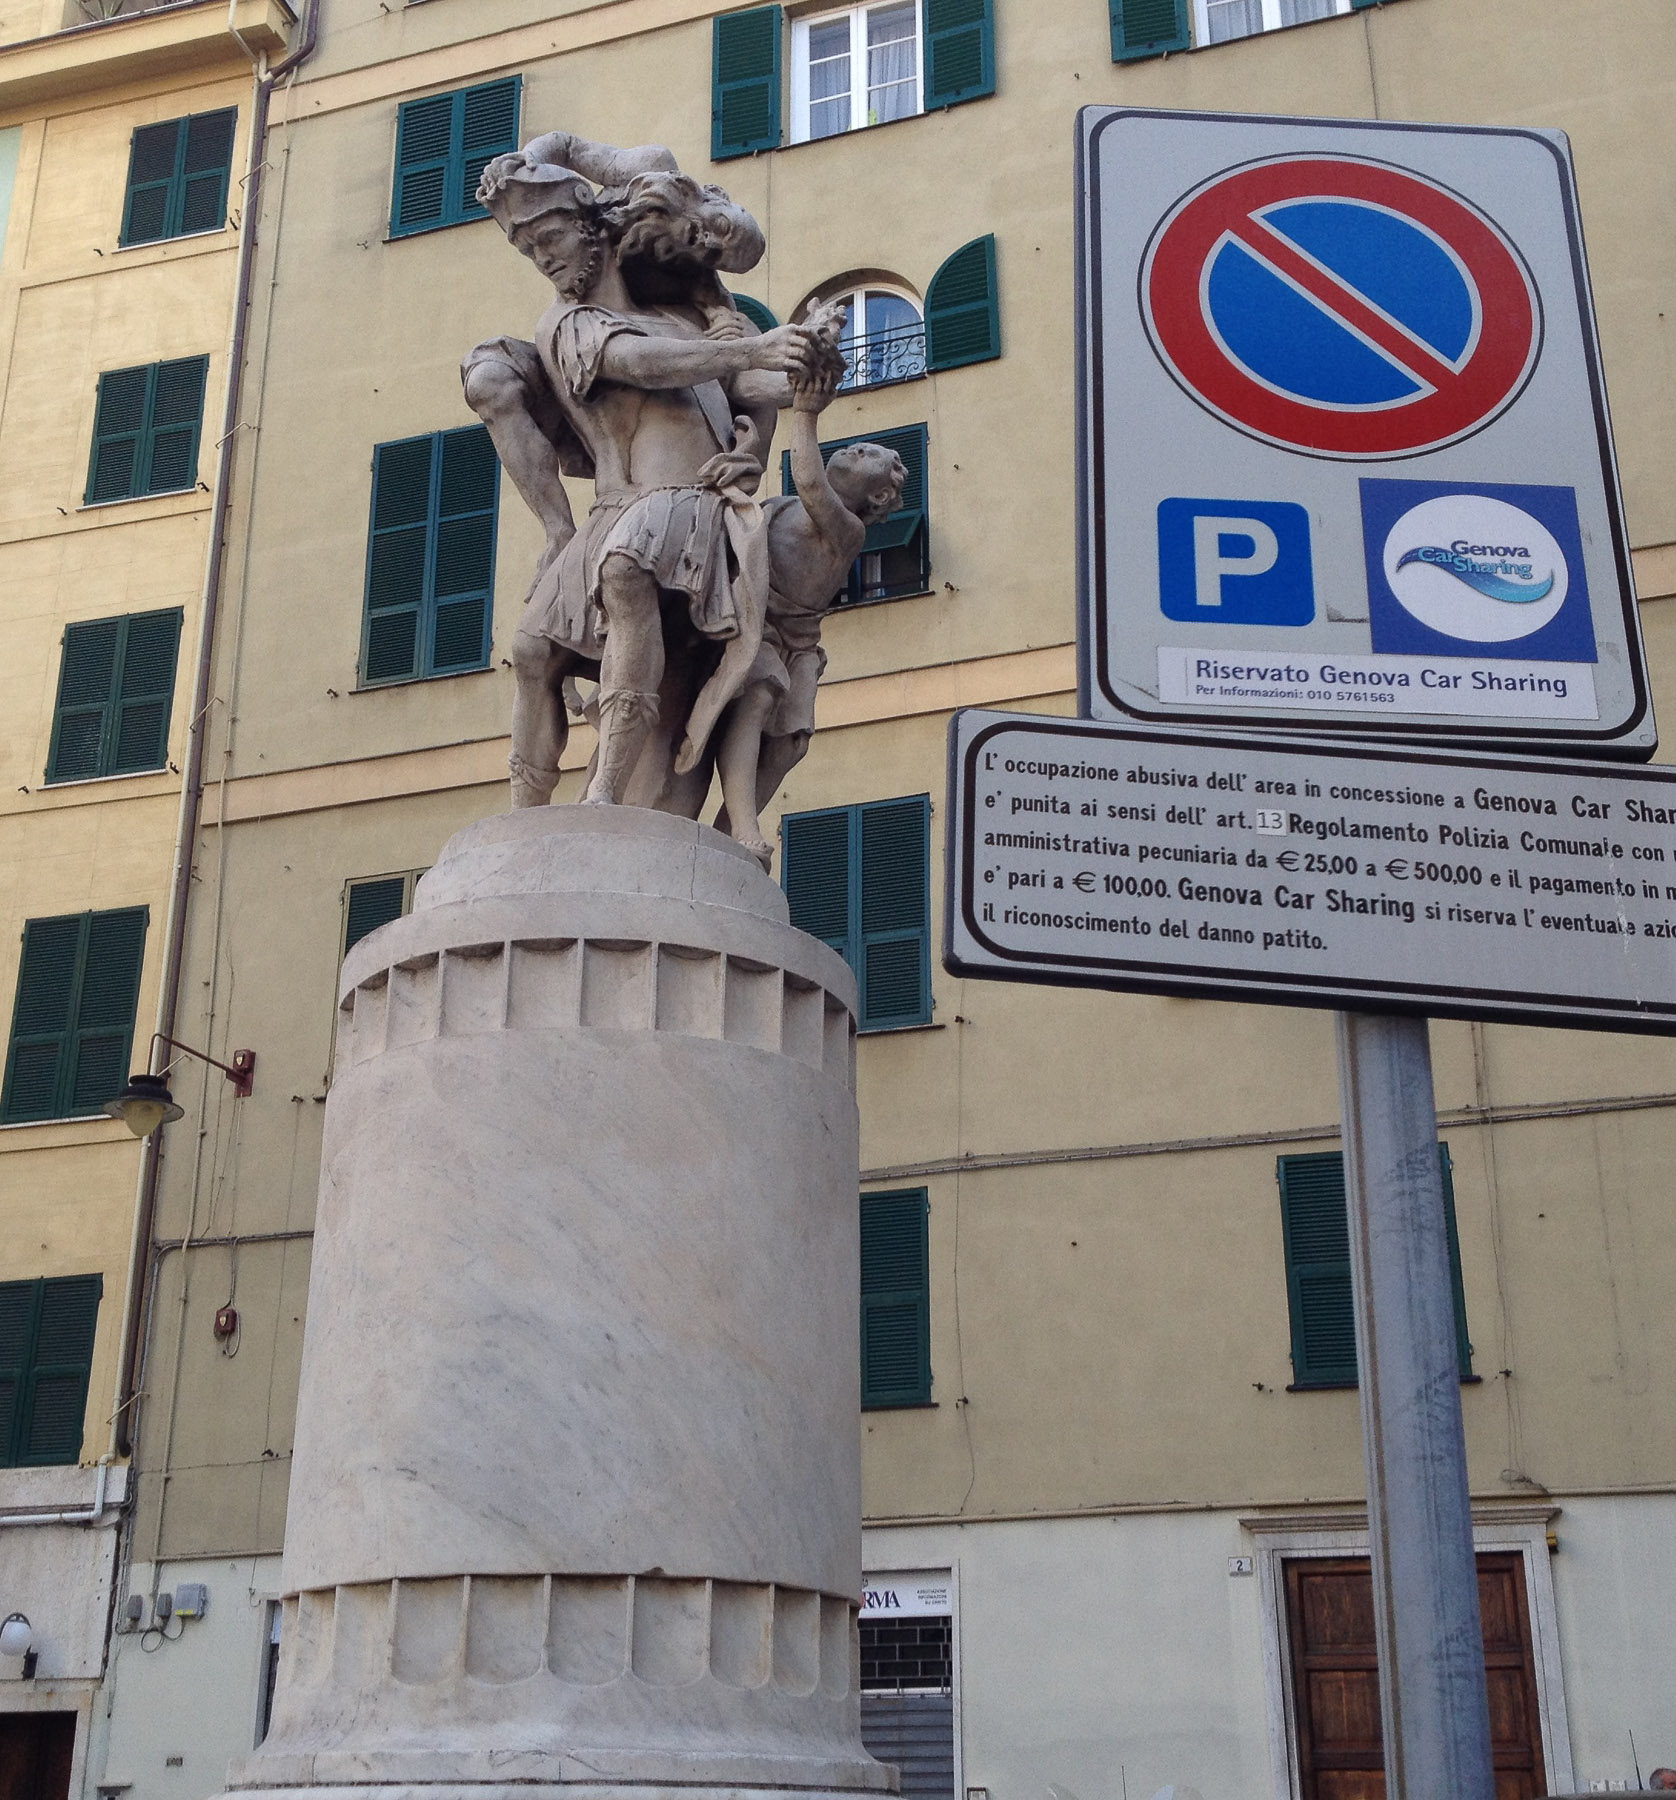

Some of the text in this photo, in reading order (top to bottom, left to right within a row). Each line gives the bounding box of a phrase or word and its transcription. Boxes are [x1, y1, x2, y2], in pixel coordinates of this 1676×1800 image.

[1193, 515, 1279, 607] P
[1450, 540, 1531, 558] Genova
[1453, 556, 1533, 580] Sharing
[1195, 685, 1395, 703] Per Informazioni: 010 5761563
[1196, 660, 1567, 698] Riservato Genova Car Sharing
[1004, 759, 1119, 781] occupazione
[1126, 765, 1199, 788] abusiva
[1206, 771, 1247, 792] dell'
[1255, 780, 1297, 796] area
[1304, 779, 1321, 798] in
[1330, 784, 1445, 807] concessione
[1454, 795, 1465, 809] a
[1473, 787, 1557, 816] Genova
[1571, 795, 1611, 820] Car
[984, 791, 1002, 809] e'
[1011, 795, 1070, 816] punita
[1080, 799, 1097, 817] ai
[1107, 803, 1156, 822] sensi
[1165, 805, 1206, 826] dell'
[1216, 811, 1253, 830] art.
[1257, 812, 1283, 830] 13
[1289, 813, 1429, 843] Regolamento
[1439, 824, 1509, 850] Polizia
[1520, 831, 1624, 859] Comunale
[1631, 846, 1665, 862] con
[984, 830, 1130, 857] amministrativa
[1138, 843, 1238, 866] pecuniaria
[1245, 849, 1268, 868] da
[1365, 862, 1377, 877] a
[1490, 872, 1501, 887] e
[1508, 869, 1522, 889] il
[1529, 875, 1636, 897] pagamento
[1642, 879, 1659, 899] in
[983, 865, 1001, 883] e'
[1008, 869, 1045, 890] pari
[1053, 874, 1064, 890] a
[1177, 877, 1262, 906] Genova
[1274, 885, 1315, 910] Car
[1326, 888, 1415, 923] Sharing
[1425, 901, 1441, 920] si
[1448, 903, 1517, 927] riserva
[983, 903, 1328, 951] il riconoscimento del danno patito.
[1236, 1560, 1244, 1571] 2
